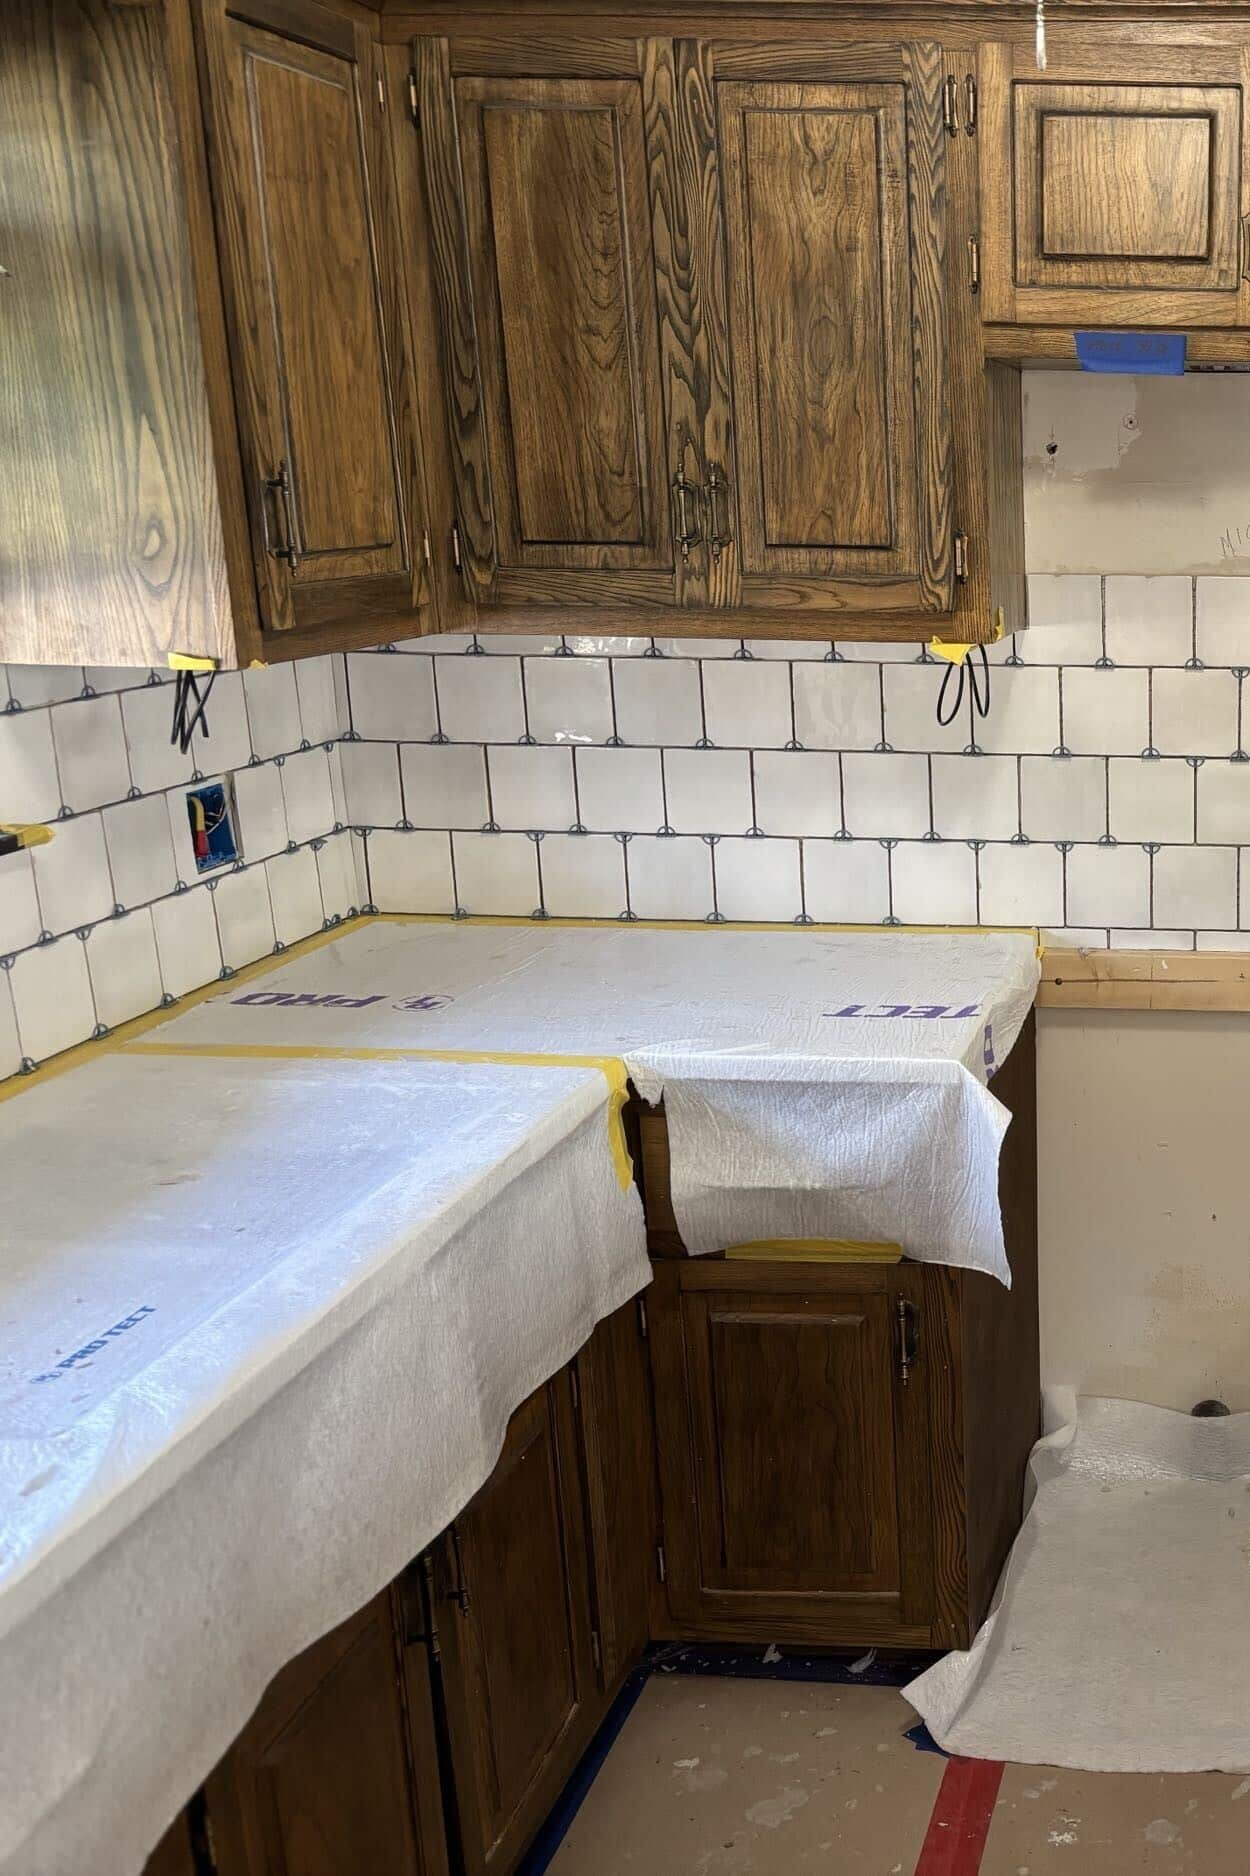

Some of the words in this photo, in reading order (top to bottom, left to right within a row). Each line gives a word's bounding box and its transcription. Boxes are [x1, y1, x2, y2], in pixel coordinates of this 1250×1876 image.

[230, 992, 389, 1008] PRO
[822, 1004, 983, 1019] TECT
[56, 1339, 109, 1369] PRO
[101, 1305, 157, 1337] TECT
